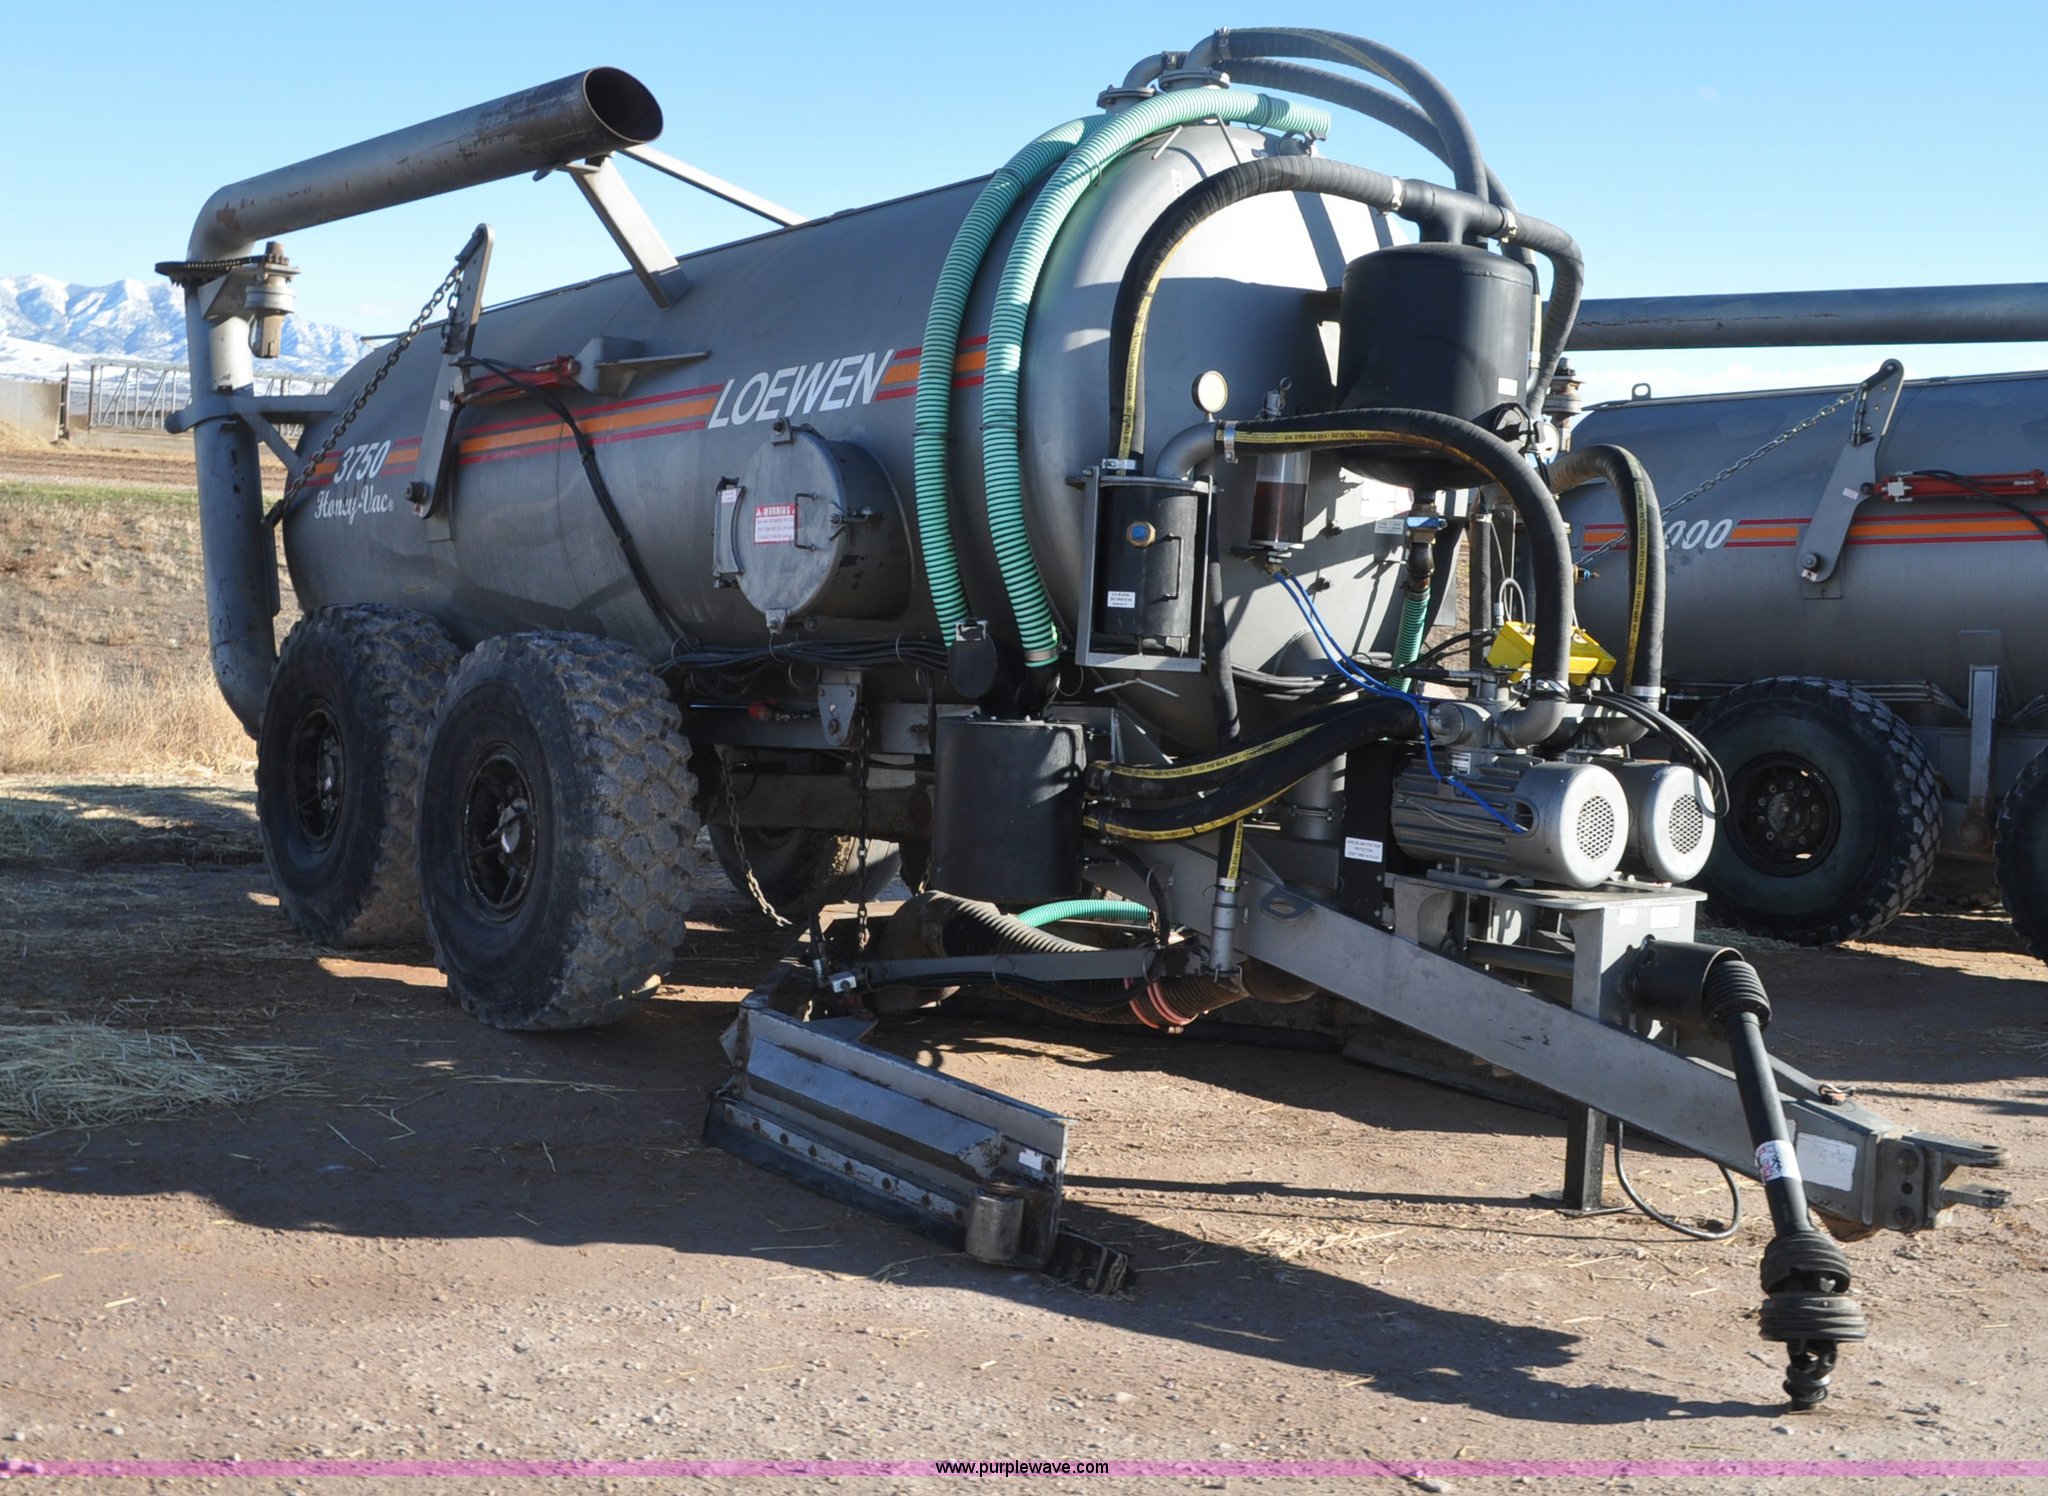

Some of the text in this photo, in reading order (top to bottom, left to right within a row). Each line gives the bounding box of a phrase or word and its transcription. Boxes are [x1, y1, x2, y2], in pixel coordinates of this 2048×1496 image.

[708, 349, 894, 429] LOEWEN
[333, 440, 391, 484] 3750
[1662, 518, 1733, 550] 000
